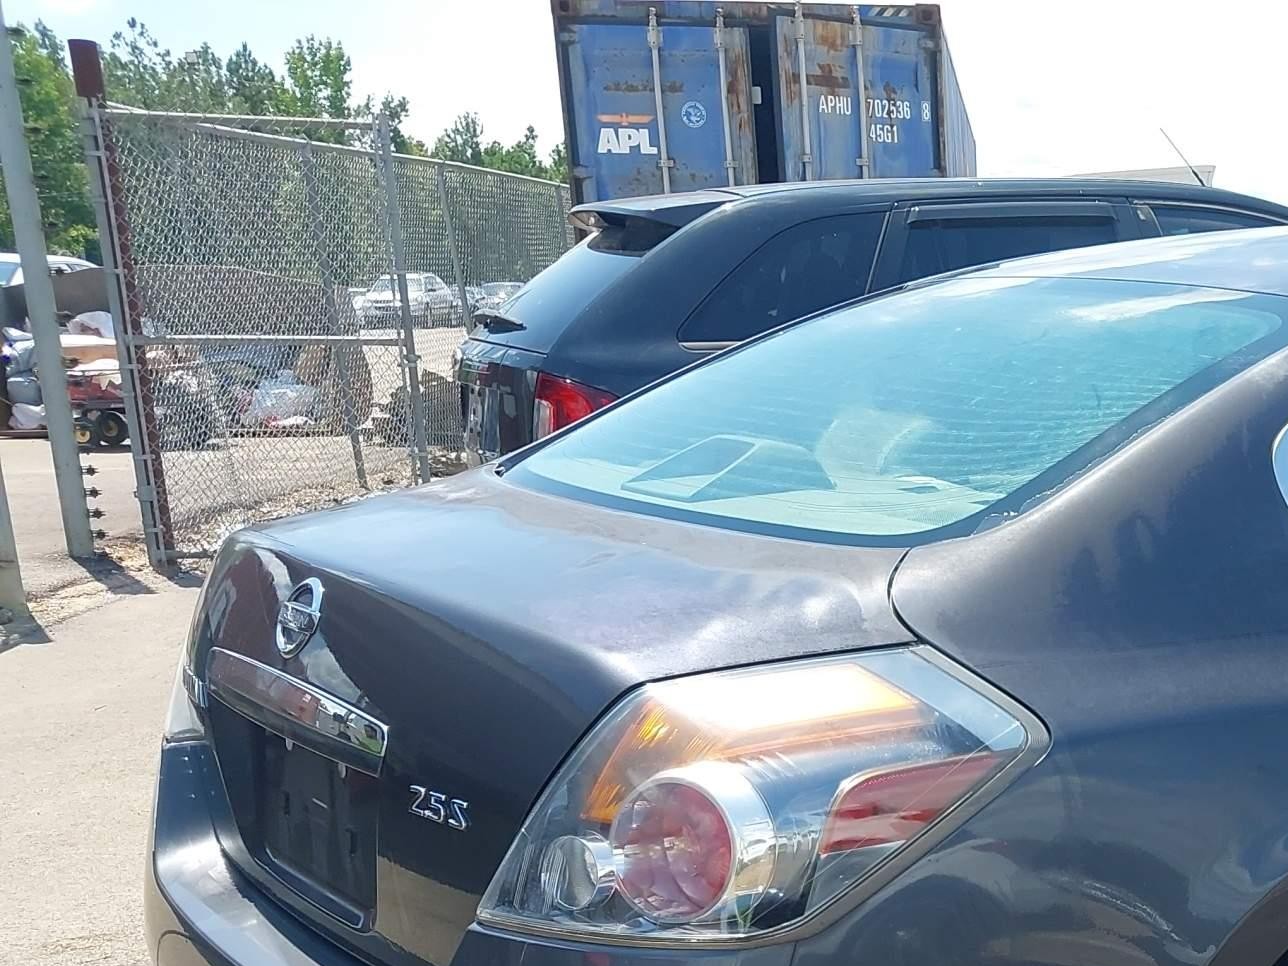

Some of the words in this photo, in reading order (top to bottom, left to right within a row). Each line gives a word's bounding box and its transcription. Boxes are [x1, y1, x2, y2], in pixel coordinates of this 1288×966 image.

[819, 95, 852, 115] APHU
[867, 99, 911, 119] 702536
[922, 102, 930, 120] 8
[597, 127, 658, 154] APL
[869, 124, 898, 143] 45G1
